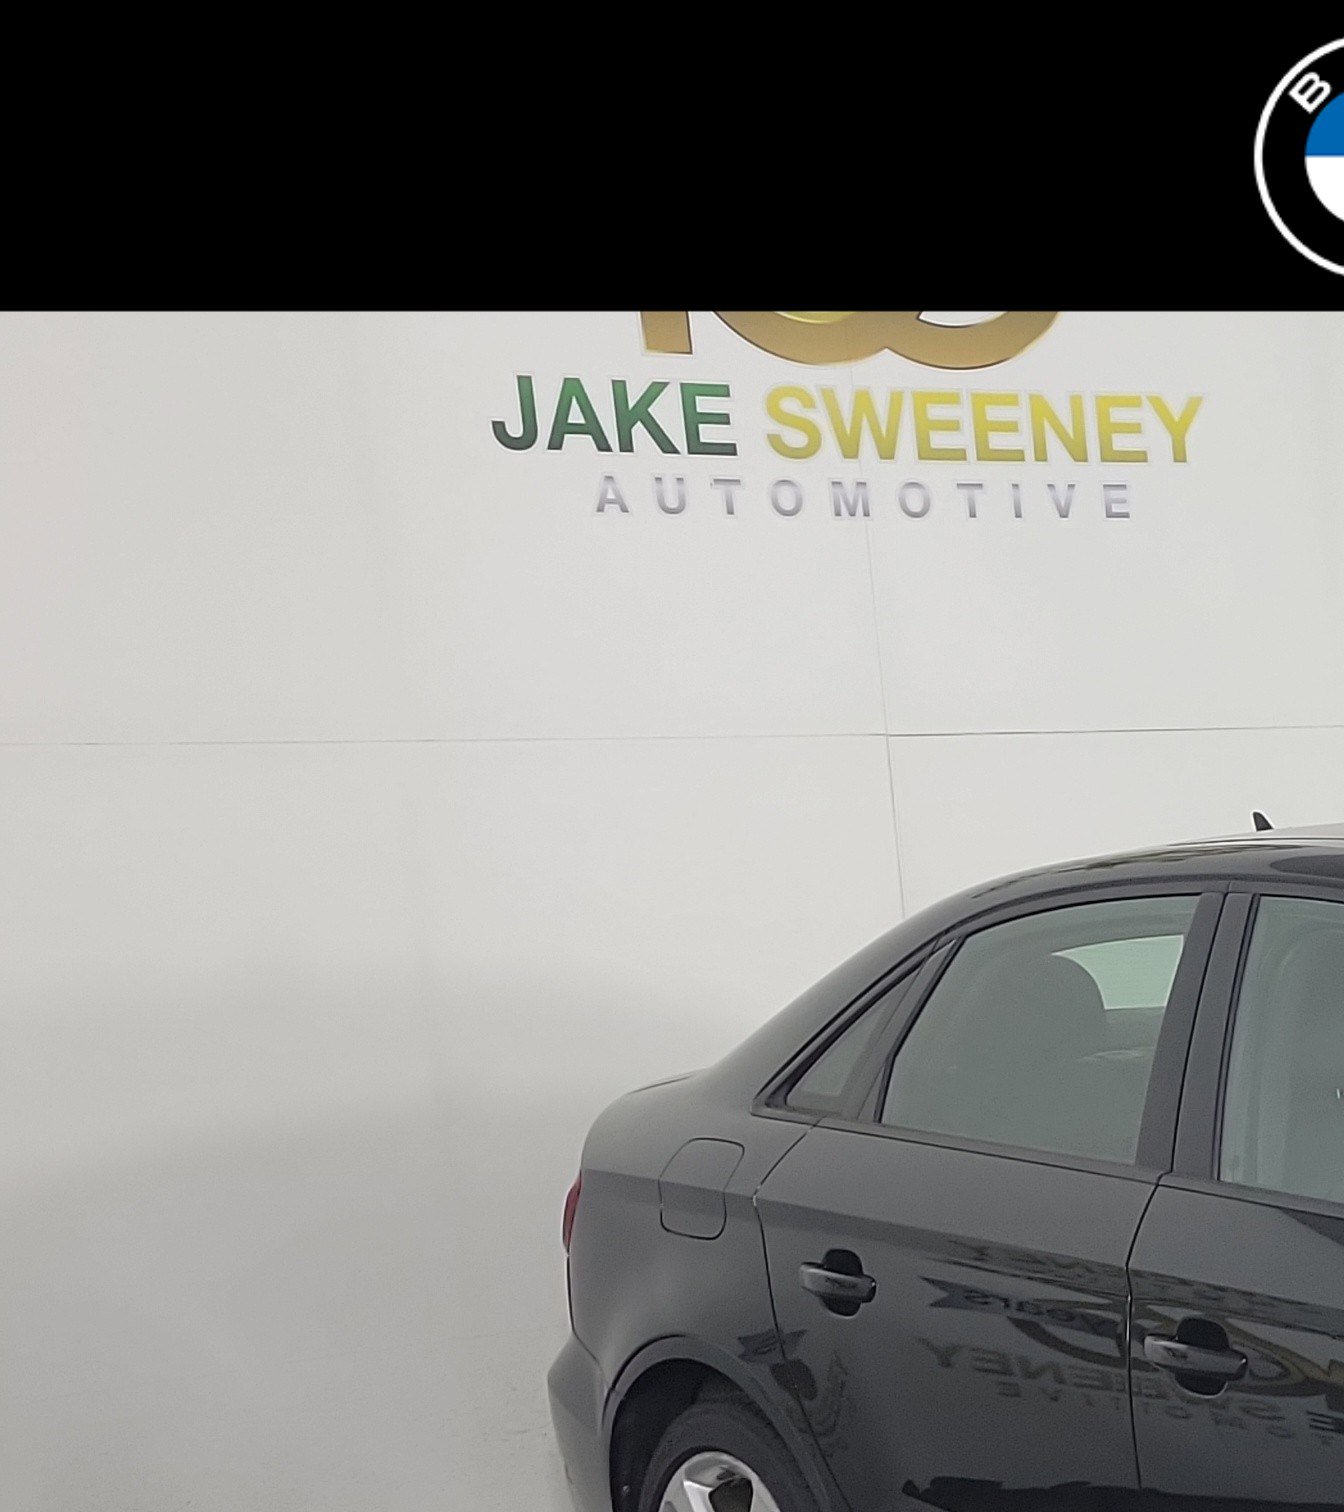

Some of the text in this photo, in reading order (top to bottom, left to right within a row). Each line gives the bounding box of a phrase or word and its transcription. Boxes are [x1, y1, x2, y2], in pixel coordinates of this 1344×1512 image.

[491, 375, 1203, 463] JAKE SWEENEY
[595, 475, 1131, 519] AUTOMOTIVE
